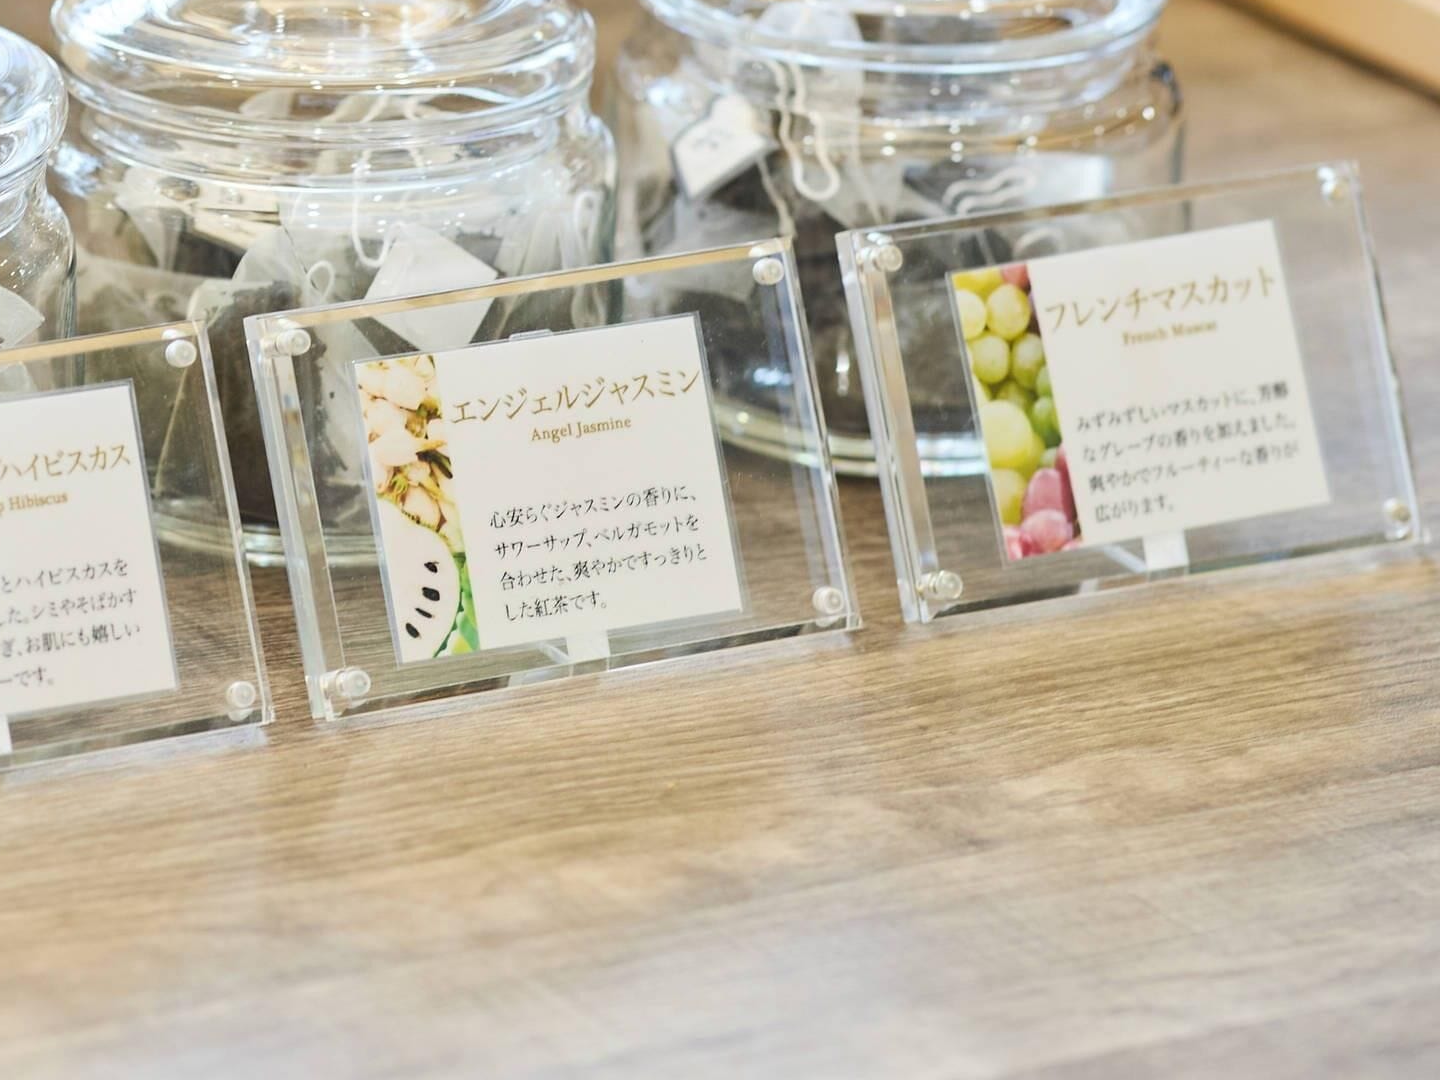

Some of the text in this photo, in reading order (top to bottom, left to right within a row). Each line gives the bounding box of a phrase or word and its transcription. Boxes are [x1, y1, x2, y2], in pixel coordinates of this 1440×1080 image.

[1046, 266, 1275, 333] フレンチマスカット
[1122, 328, 1167, 345] French
[451, 370, 700, 424] エンジェルジャスミン
[531, 417, 632, 443] Angel Jasmine
[9, 492, 69, 511] Hibiscus
[490, 486, 697, 529] 心安らぐジャスミンの香りに、
[1095, 495, 1174, 523] 広がります。
[495, 513, 700, 560] サワーサップ、ベルガモットを
[500, 543, 708, 591] 合わせた、爽やかですっきりと
[504, 590, 608, 621] した紅茶です。
